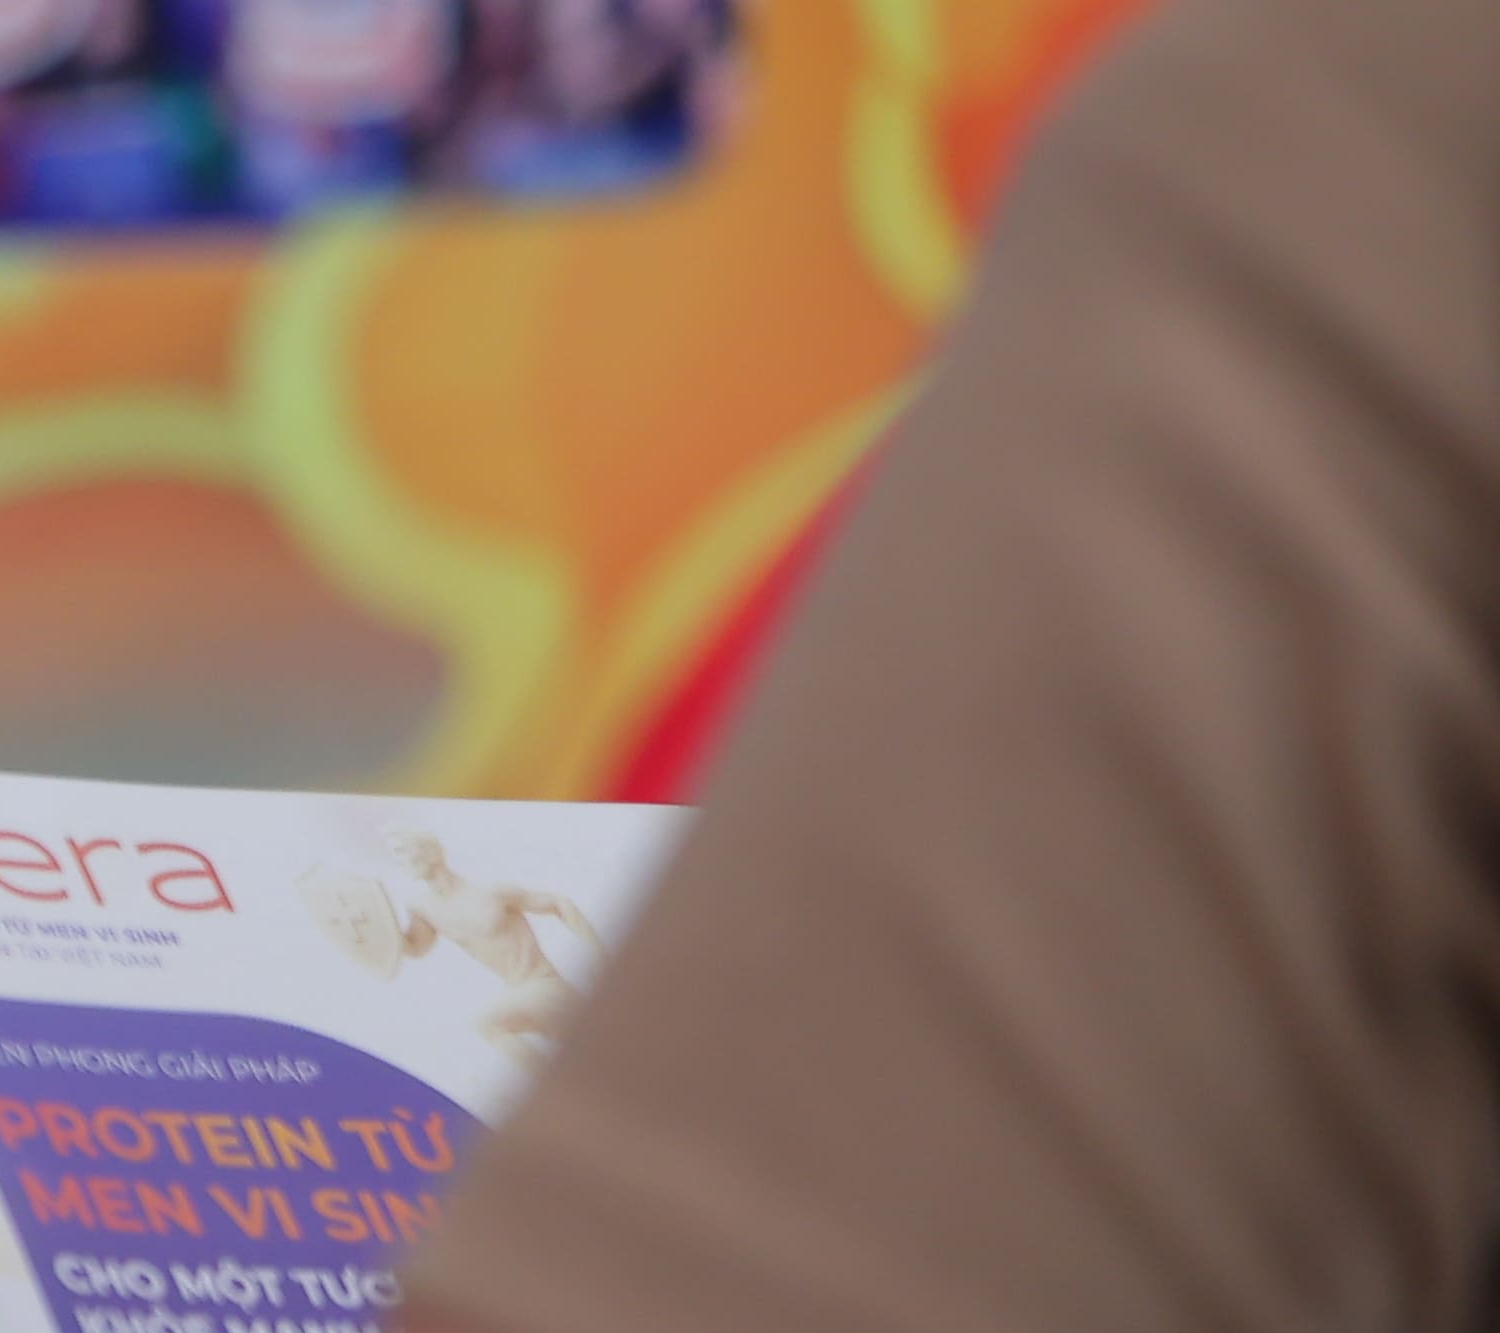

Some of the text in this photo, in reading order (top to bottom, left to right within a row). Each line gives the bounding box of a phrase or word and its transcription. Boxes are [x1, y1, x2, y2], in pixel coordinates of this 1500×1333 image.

[32, 1043, 154, 1076] PHONG
[340, 1106, 455, 1172] TỪ
[18, 1168, 205, 1237] MEN
[208, 1186, 305, 1241] VI
[53, 1253, 168, 1300] CHO
[169, 1257, 285, 1314] MỘT
